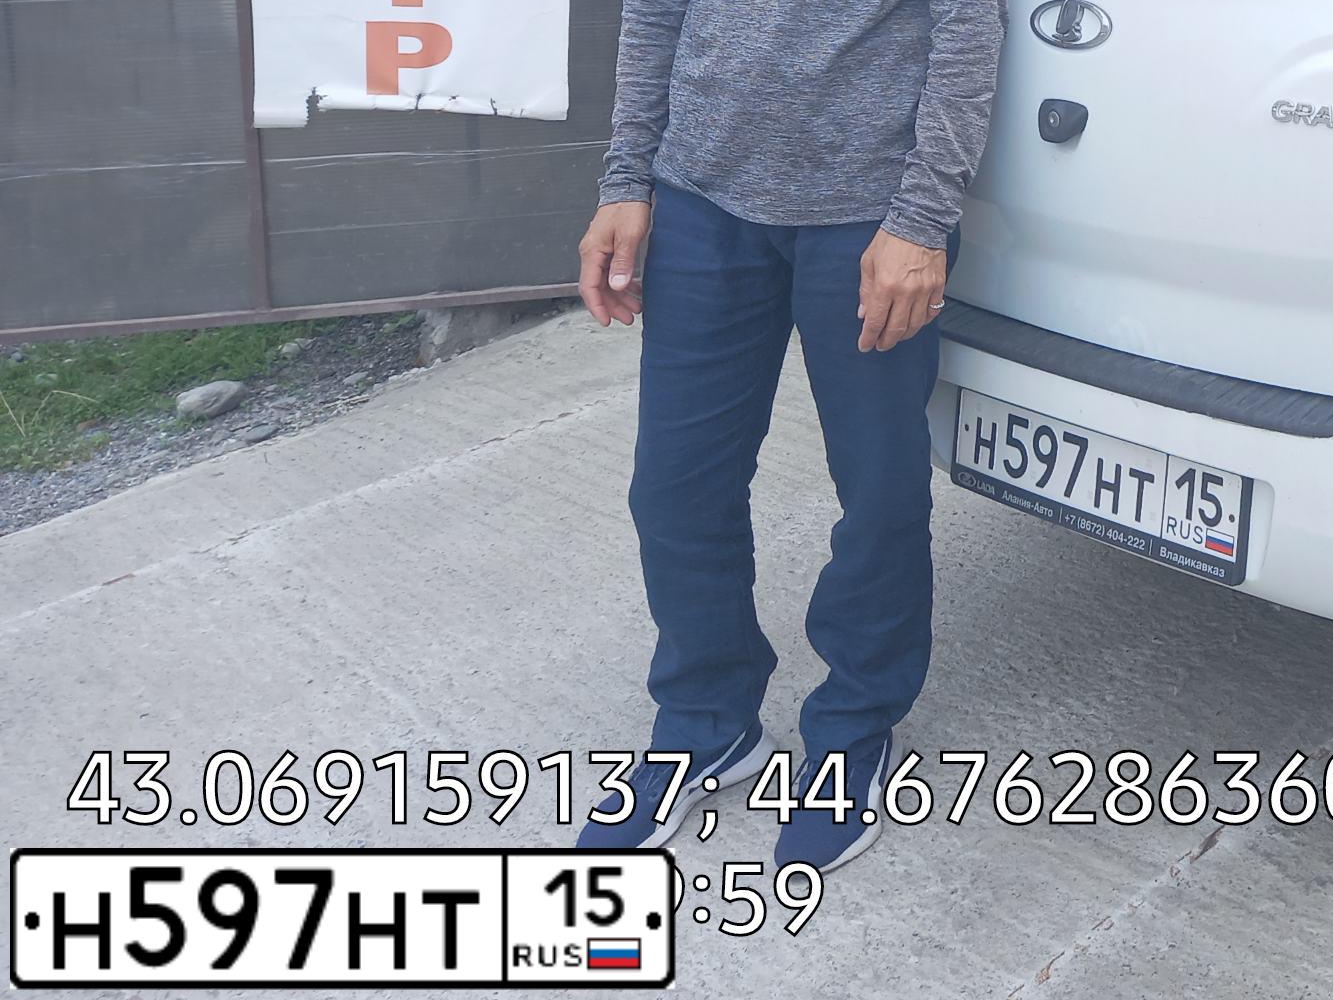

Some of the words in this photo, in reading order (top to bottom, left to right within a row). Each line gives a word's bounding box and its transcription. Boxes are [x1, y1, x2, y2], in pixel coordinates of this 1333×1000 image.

[973, 412, 1155, 523] Н597НТ
[976, 479, 996, 495] LADA
[1174, 468, 1224, 528] 15
[1001, 490, 1054, 518] Алания-Авто
[1064, 513, 1077, 526] +7
[1077, 516, 1105, 538] (8672)
[1106, 528, 1146, 551] 404-222
[1166, 515, 1204, 544] RUS
[1159, 546, 1225, 578] Владикавказ
